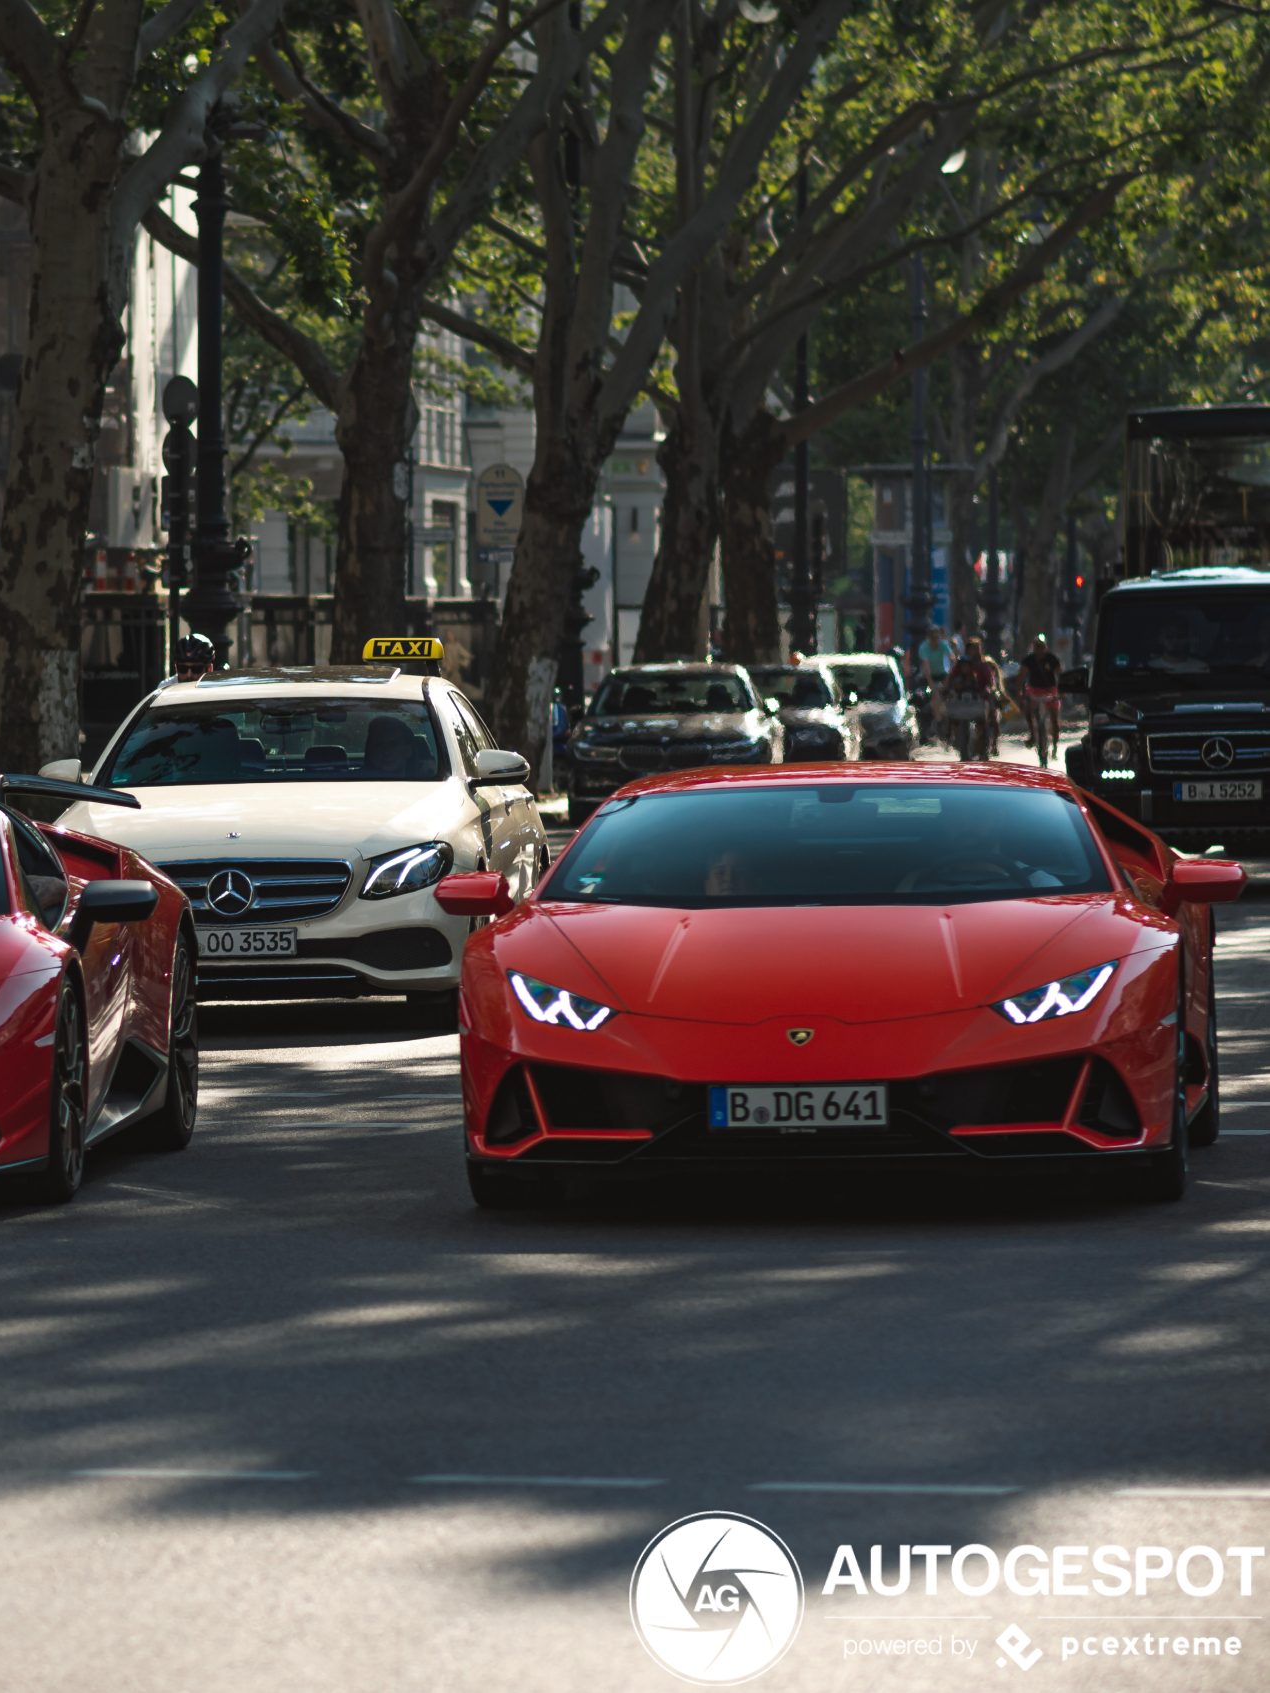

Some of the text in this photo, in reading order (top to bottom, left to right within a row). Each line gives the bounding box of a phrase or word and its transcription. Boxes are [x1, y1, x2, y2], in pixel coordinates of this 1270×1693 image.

[376, 641, 430, 655] TAXI
[1188, 784, 1256, 798] B I 5252
[239, 931, 292, 952] 3535
[731, 1090, 882, 1122] B DG 641
